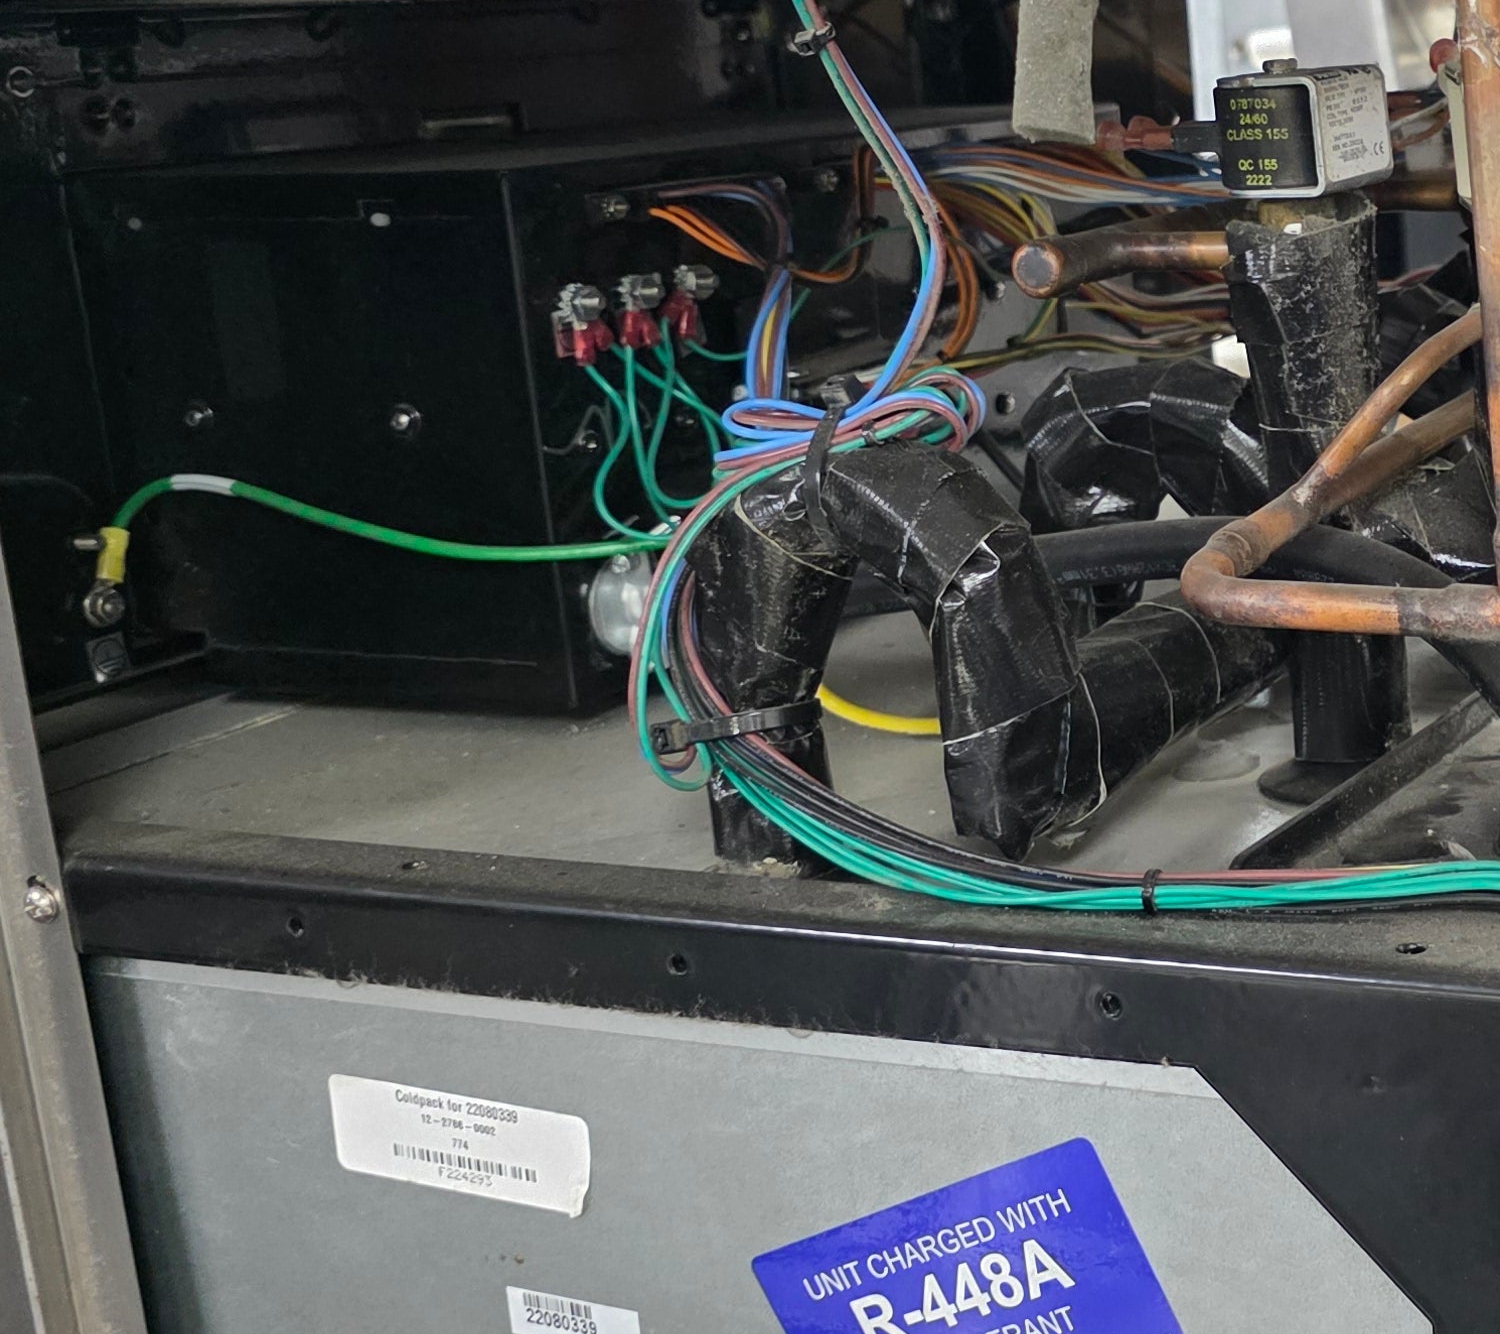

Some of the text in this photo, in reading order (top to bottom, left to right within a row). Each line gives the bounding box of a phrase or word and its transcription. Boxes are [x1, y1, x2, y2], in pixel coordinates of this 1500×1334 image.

[1226, 128, 1289, 142] CLASS 155
[1238, 158, 1279, 172] QC 155
[1245, 174, 1273, 187] 2222
[395, 1089, 518, 1124] Coldpack for 22080339
[451, 1138, 470, 1151] 774
[802, 1188, 1072, 1302] UNIT CHARGED WITH
